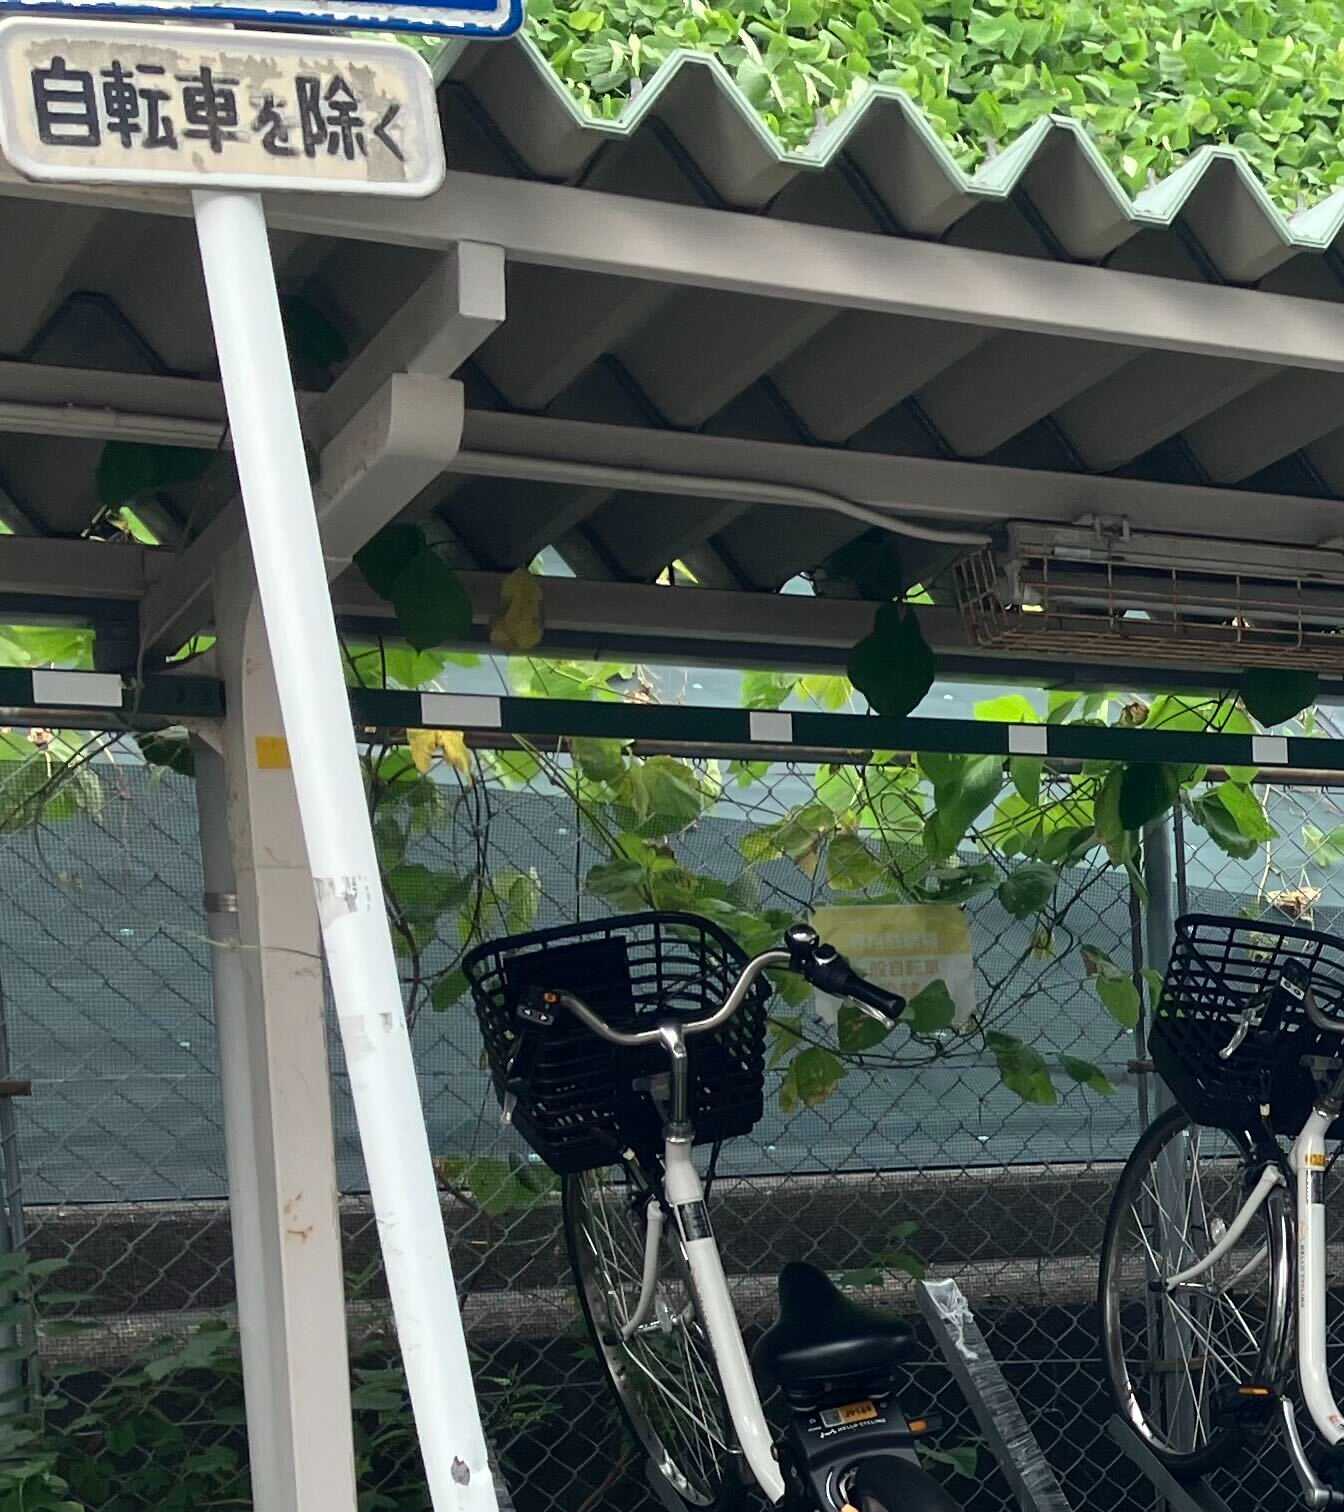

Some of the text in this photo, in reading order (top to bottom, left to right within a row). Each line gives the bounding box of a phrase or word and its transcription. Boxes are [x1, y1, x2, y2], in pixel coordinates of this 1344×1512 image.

[31, 56, 404, 161] 自転車を除く
